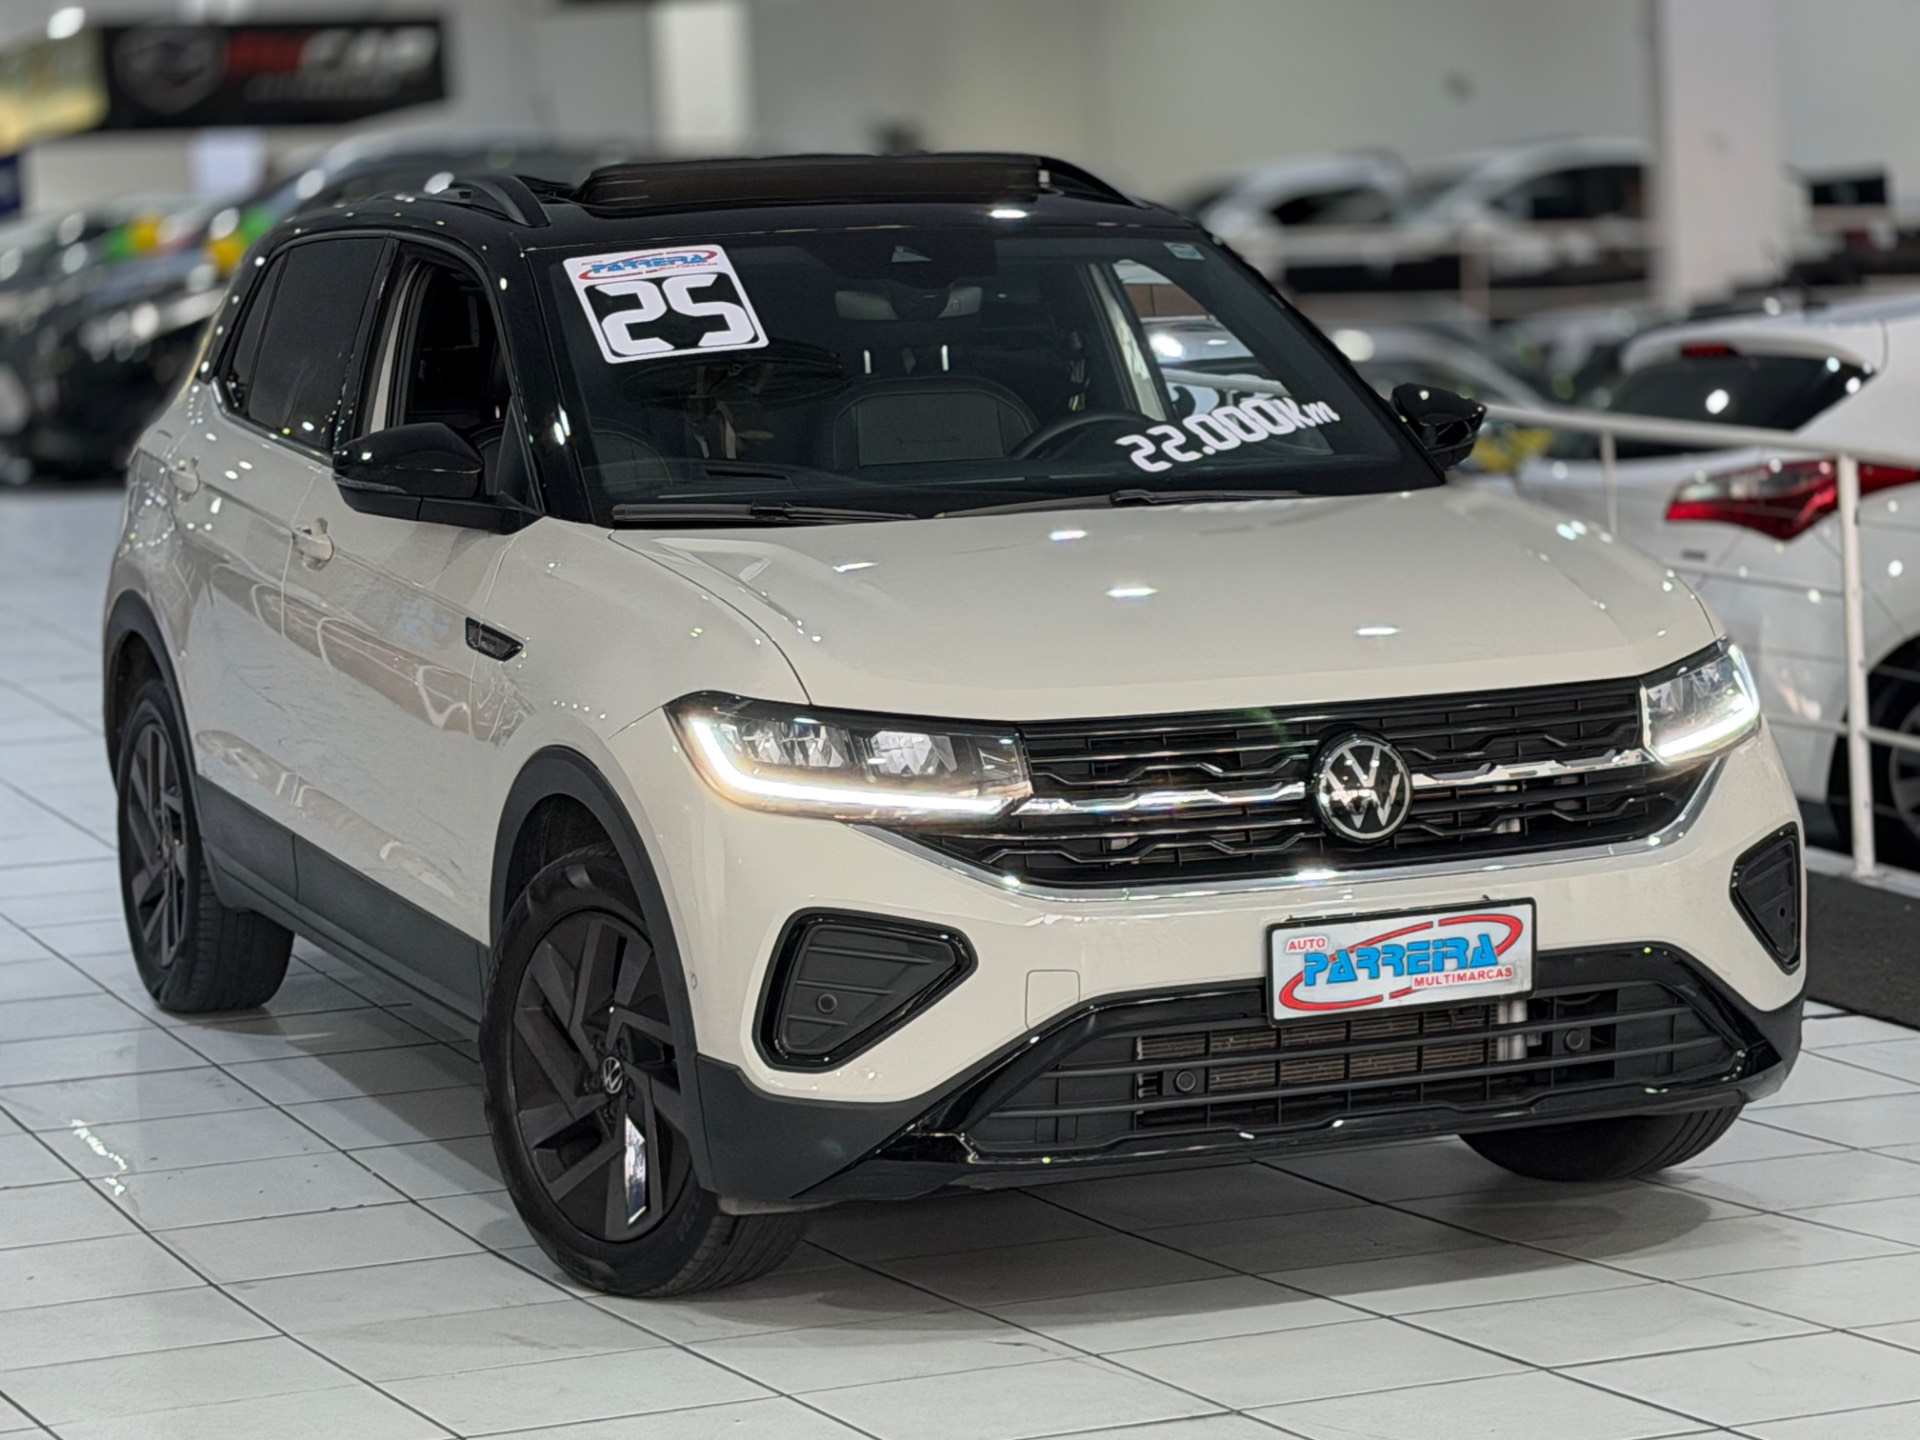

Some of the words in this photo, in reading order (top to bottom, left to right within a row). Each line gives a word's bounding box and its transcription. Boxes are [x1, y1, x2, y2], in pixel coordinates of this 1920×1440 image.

[595, 273, 755, 356] 25
[1288, 937, 1326, 951] AUTO
[1304, 933, 1498, 987] PARREIRA
[1413, 967, 1513, 988] MULTIMARCAS
